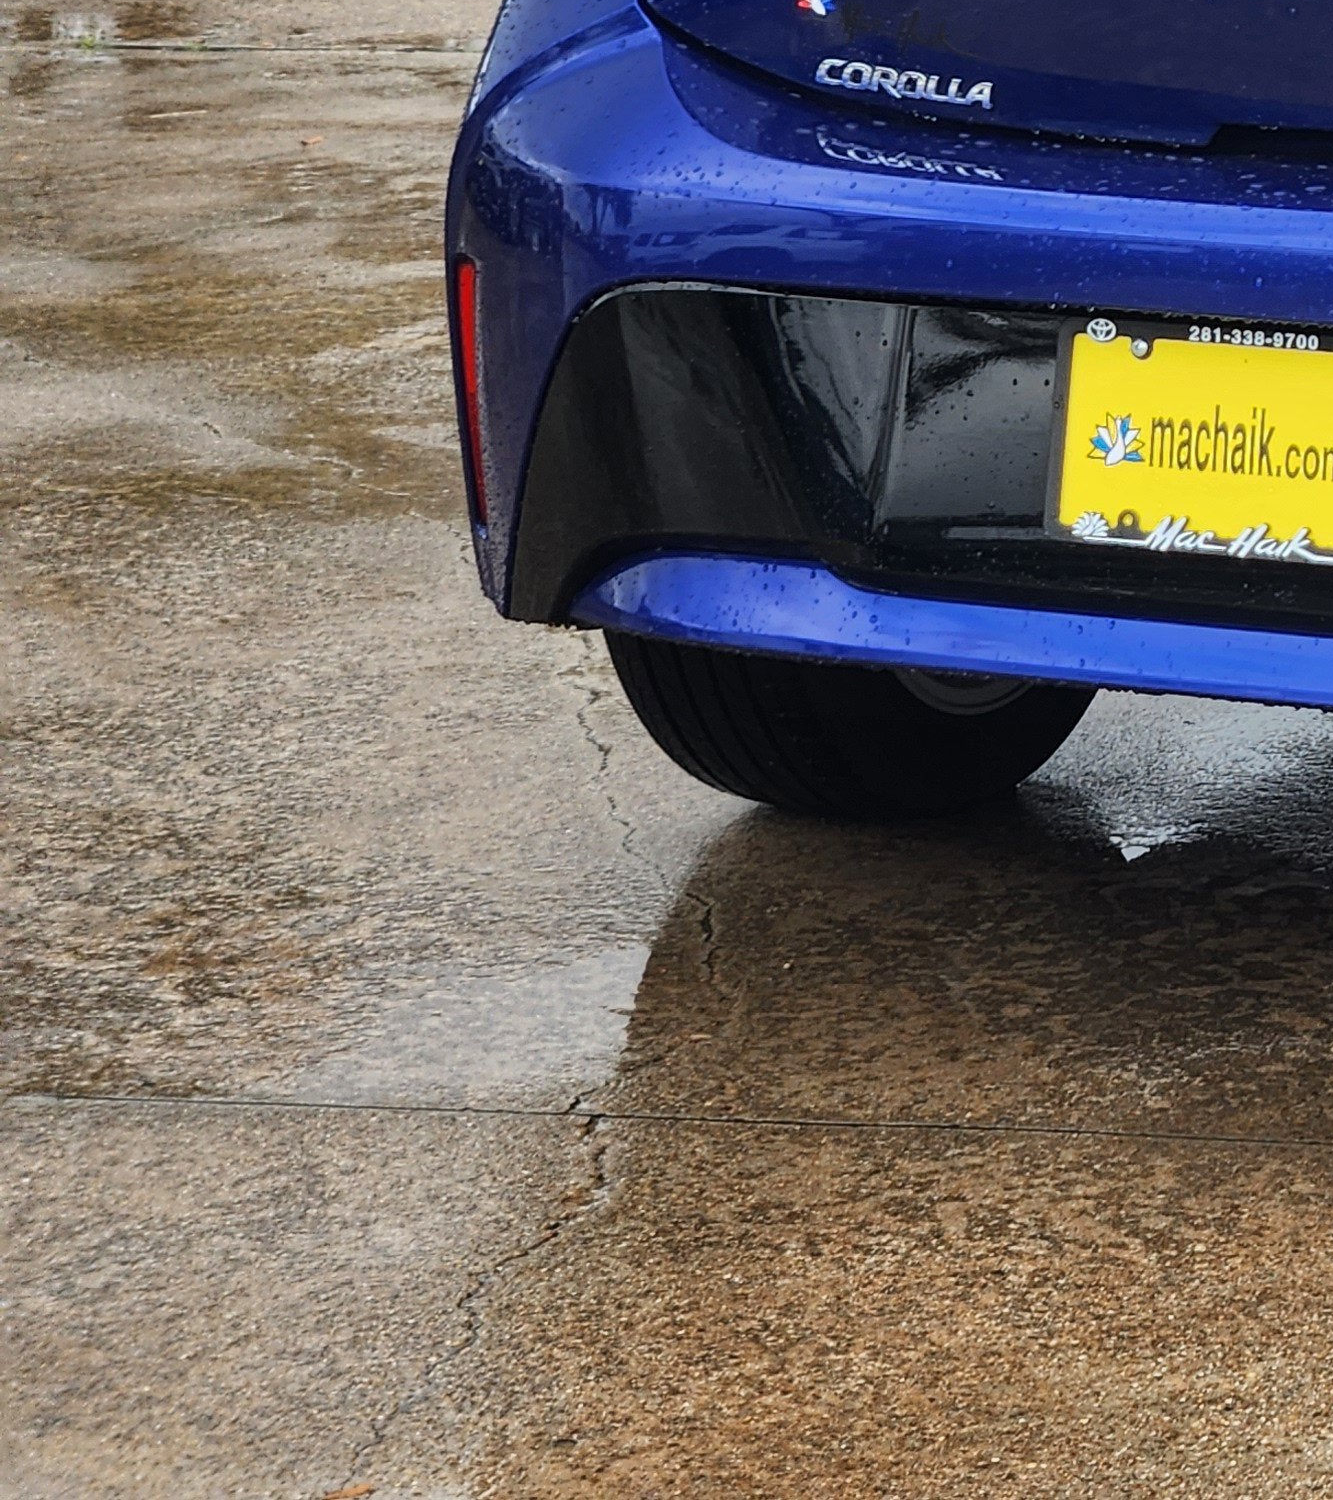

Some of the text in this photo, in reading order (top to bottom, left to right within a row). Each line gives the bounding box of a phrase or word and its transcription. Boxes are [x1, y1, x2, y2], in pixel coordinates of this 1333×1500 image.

[815, 58, 994, 110] COROLLA
[1188, 325, 1320, 351] 281-338-9700
[1143, 514, 1320, 560] Mac Haik
